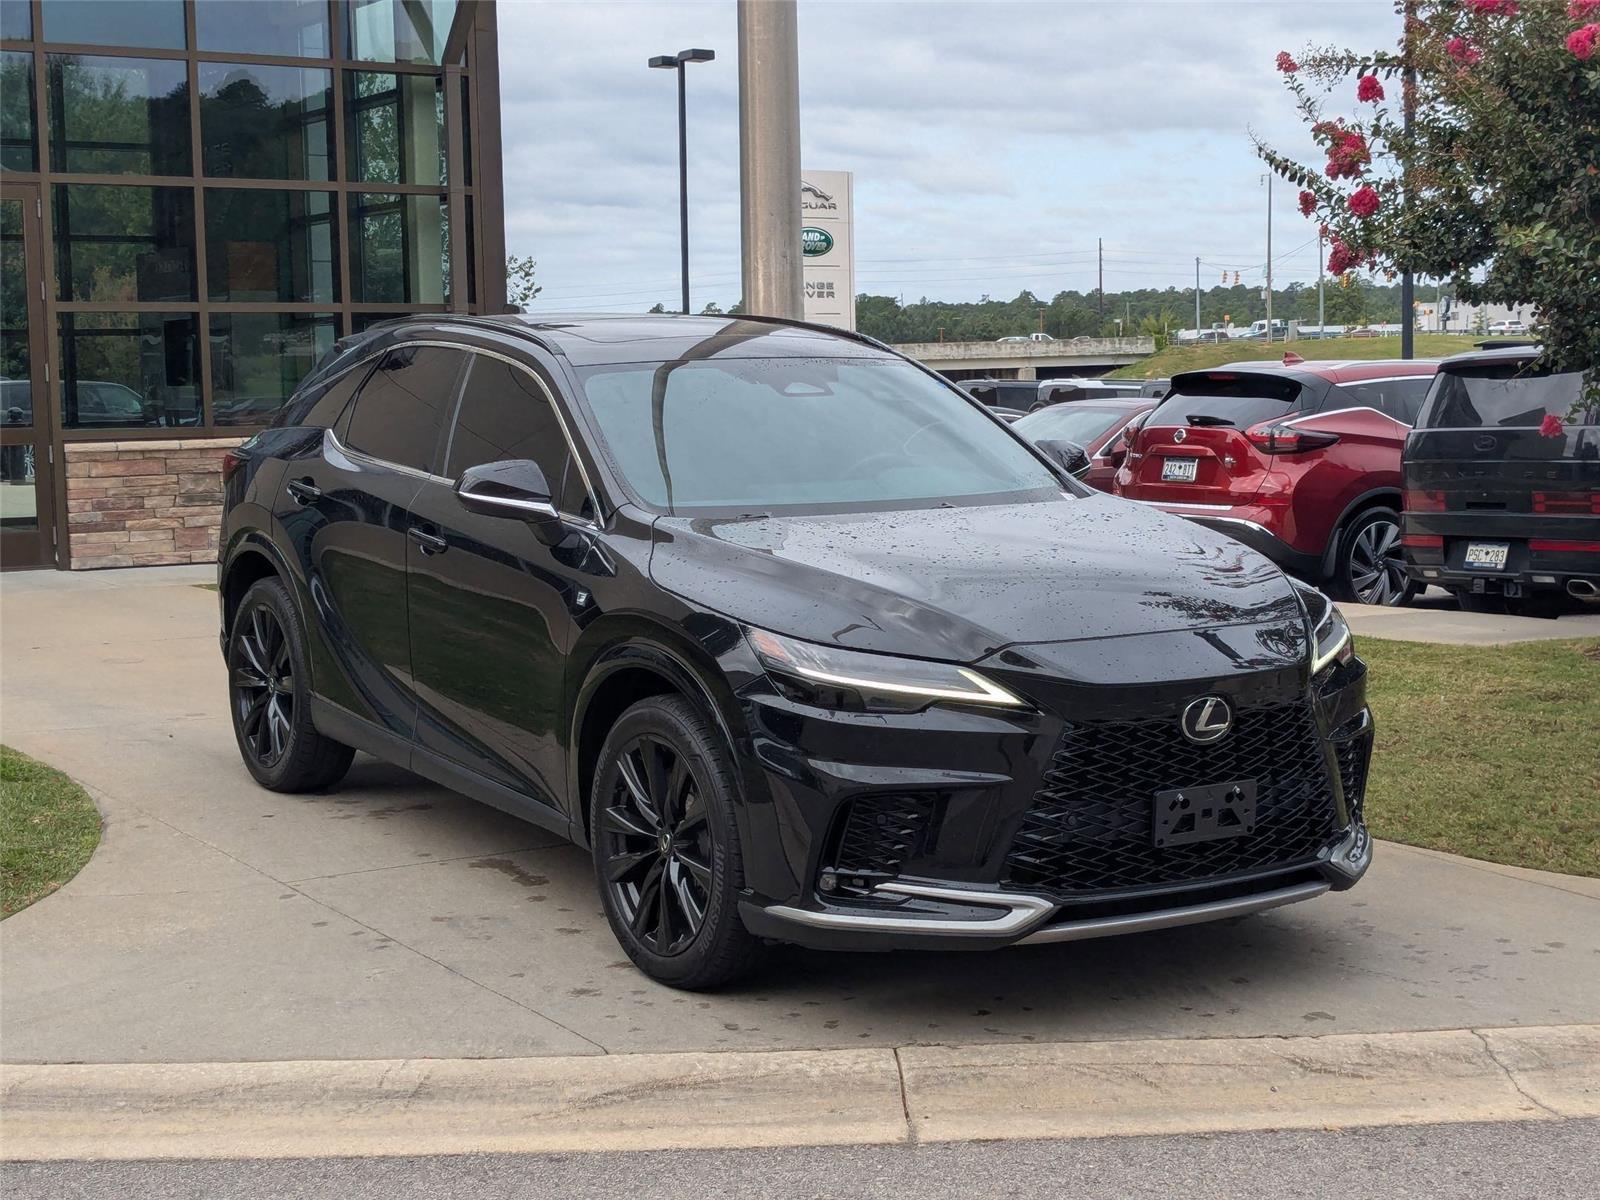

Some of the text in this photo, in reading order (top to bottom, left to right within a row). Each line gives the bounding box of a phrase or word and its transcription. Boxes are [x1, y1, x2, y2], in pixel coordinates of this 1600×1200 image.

[801, 202, 837, 210] GUAR
[803, 232, 820, 241] AND
[803, 242, 827, 250] OVER
[804, 281, 834, 290] NGE
[1165, 463, 1177, 475] 242
[1467, 548, 1505, 562] PSC 283
